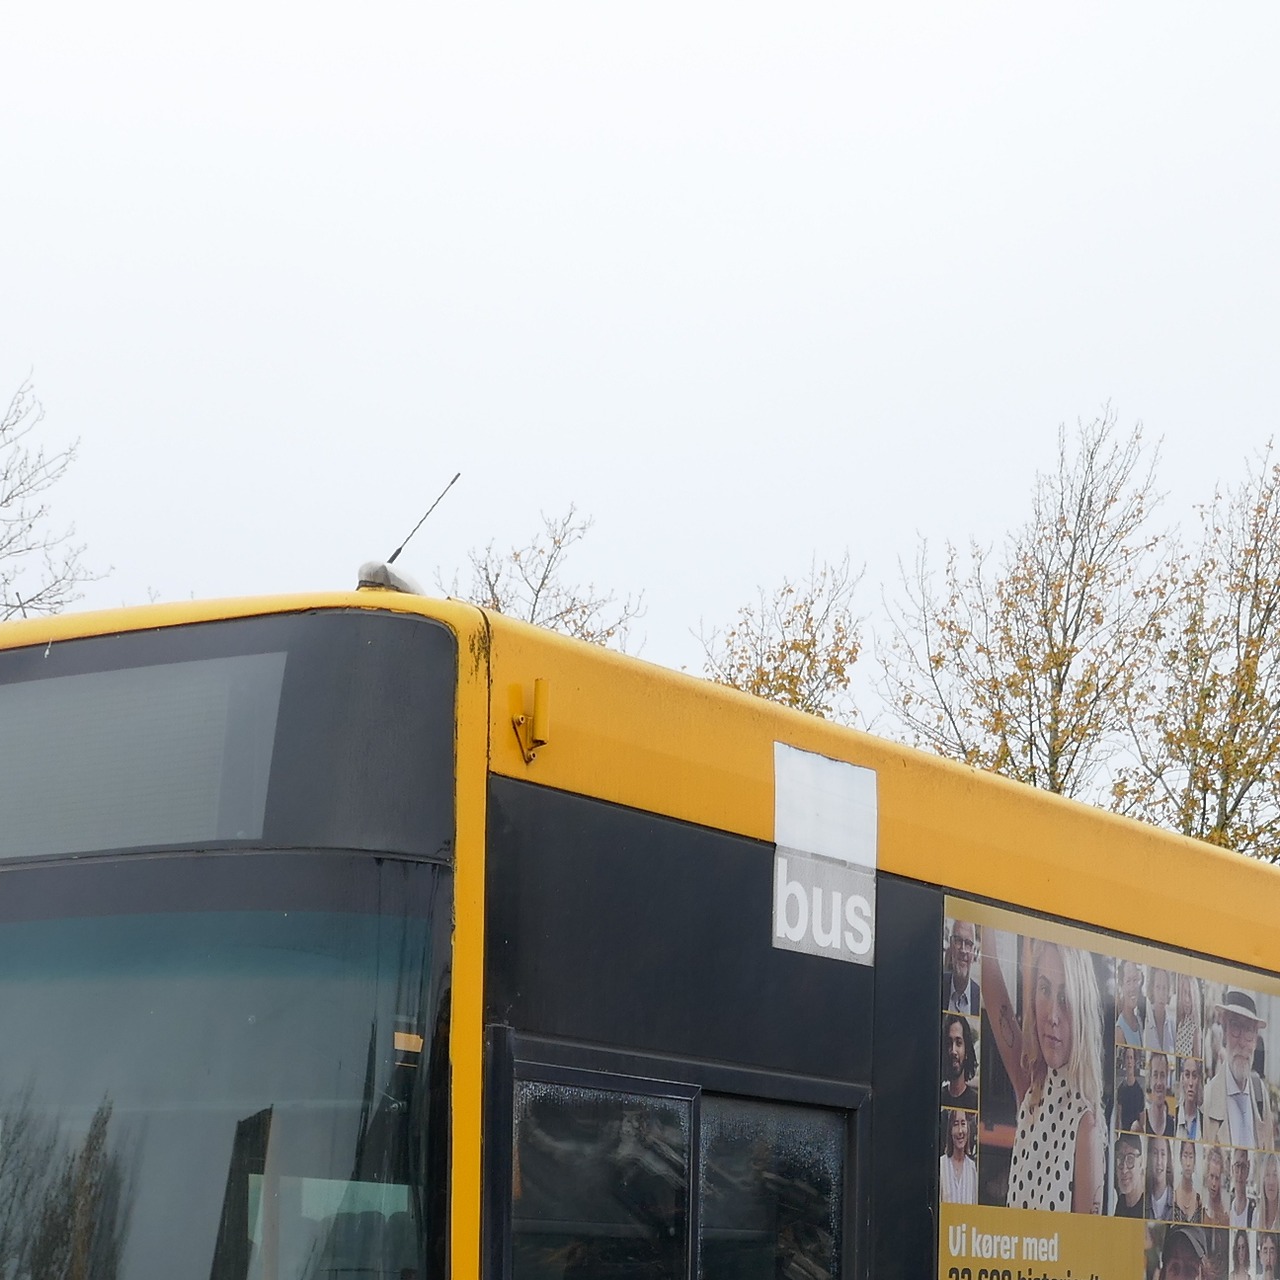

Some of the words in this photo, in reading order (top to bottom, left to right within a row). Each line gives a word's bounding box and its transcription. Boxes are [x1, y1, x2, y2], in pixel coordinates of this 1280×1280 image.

[777, 857, 872, 955] bus
[948, 1224, 966, 1257] Vi
[971, 1227, 1019, 1260] kører
[1022, 1233, 1058, 1262] med
